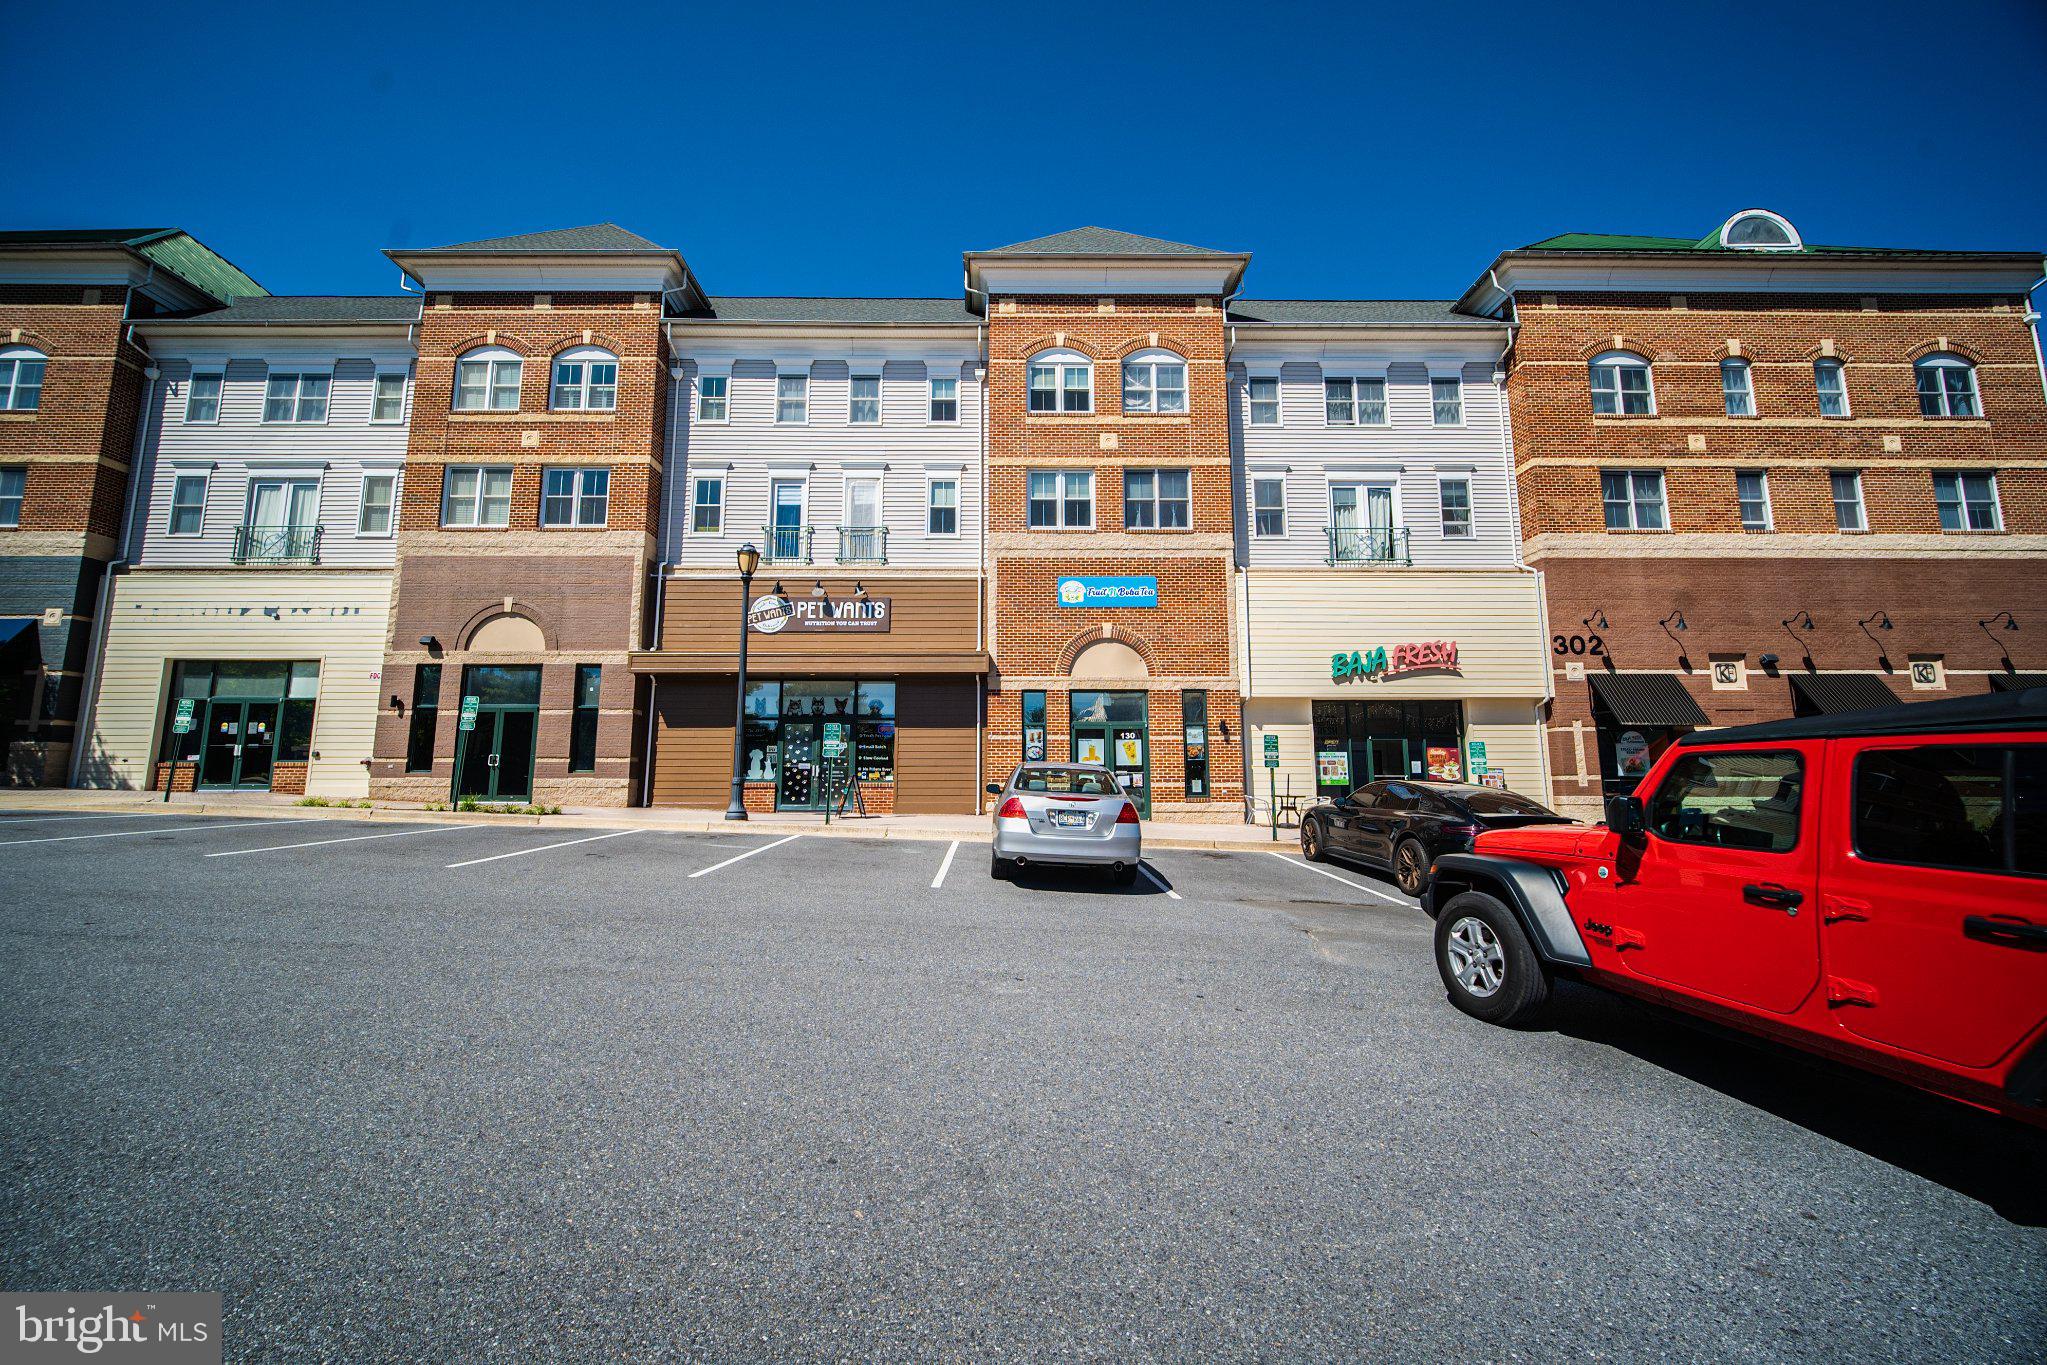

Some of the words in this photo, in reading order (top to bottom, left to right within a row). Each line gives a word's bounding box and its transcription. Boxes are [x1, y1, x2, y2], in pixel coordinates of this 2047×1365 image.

[1087, 587, 1107, 597] Fruit
[1118, 587, 1140, 596] Boba
[1141, 586, 1154, 596] Tea
[747, 613, 762, 624] PET
[763, 606, 793, 620] WANTS
[796, 601, 827, 619] PET
[831, 601, 886, 619] WANTS
[1553, 635, 1604, 655] 302
[1331, 646, 1388, 677] BAJA
[1392, 640, 1457, 666] FRESH
[1584, 918, 1612, 936] Jeep
